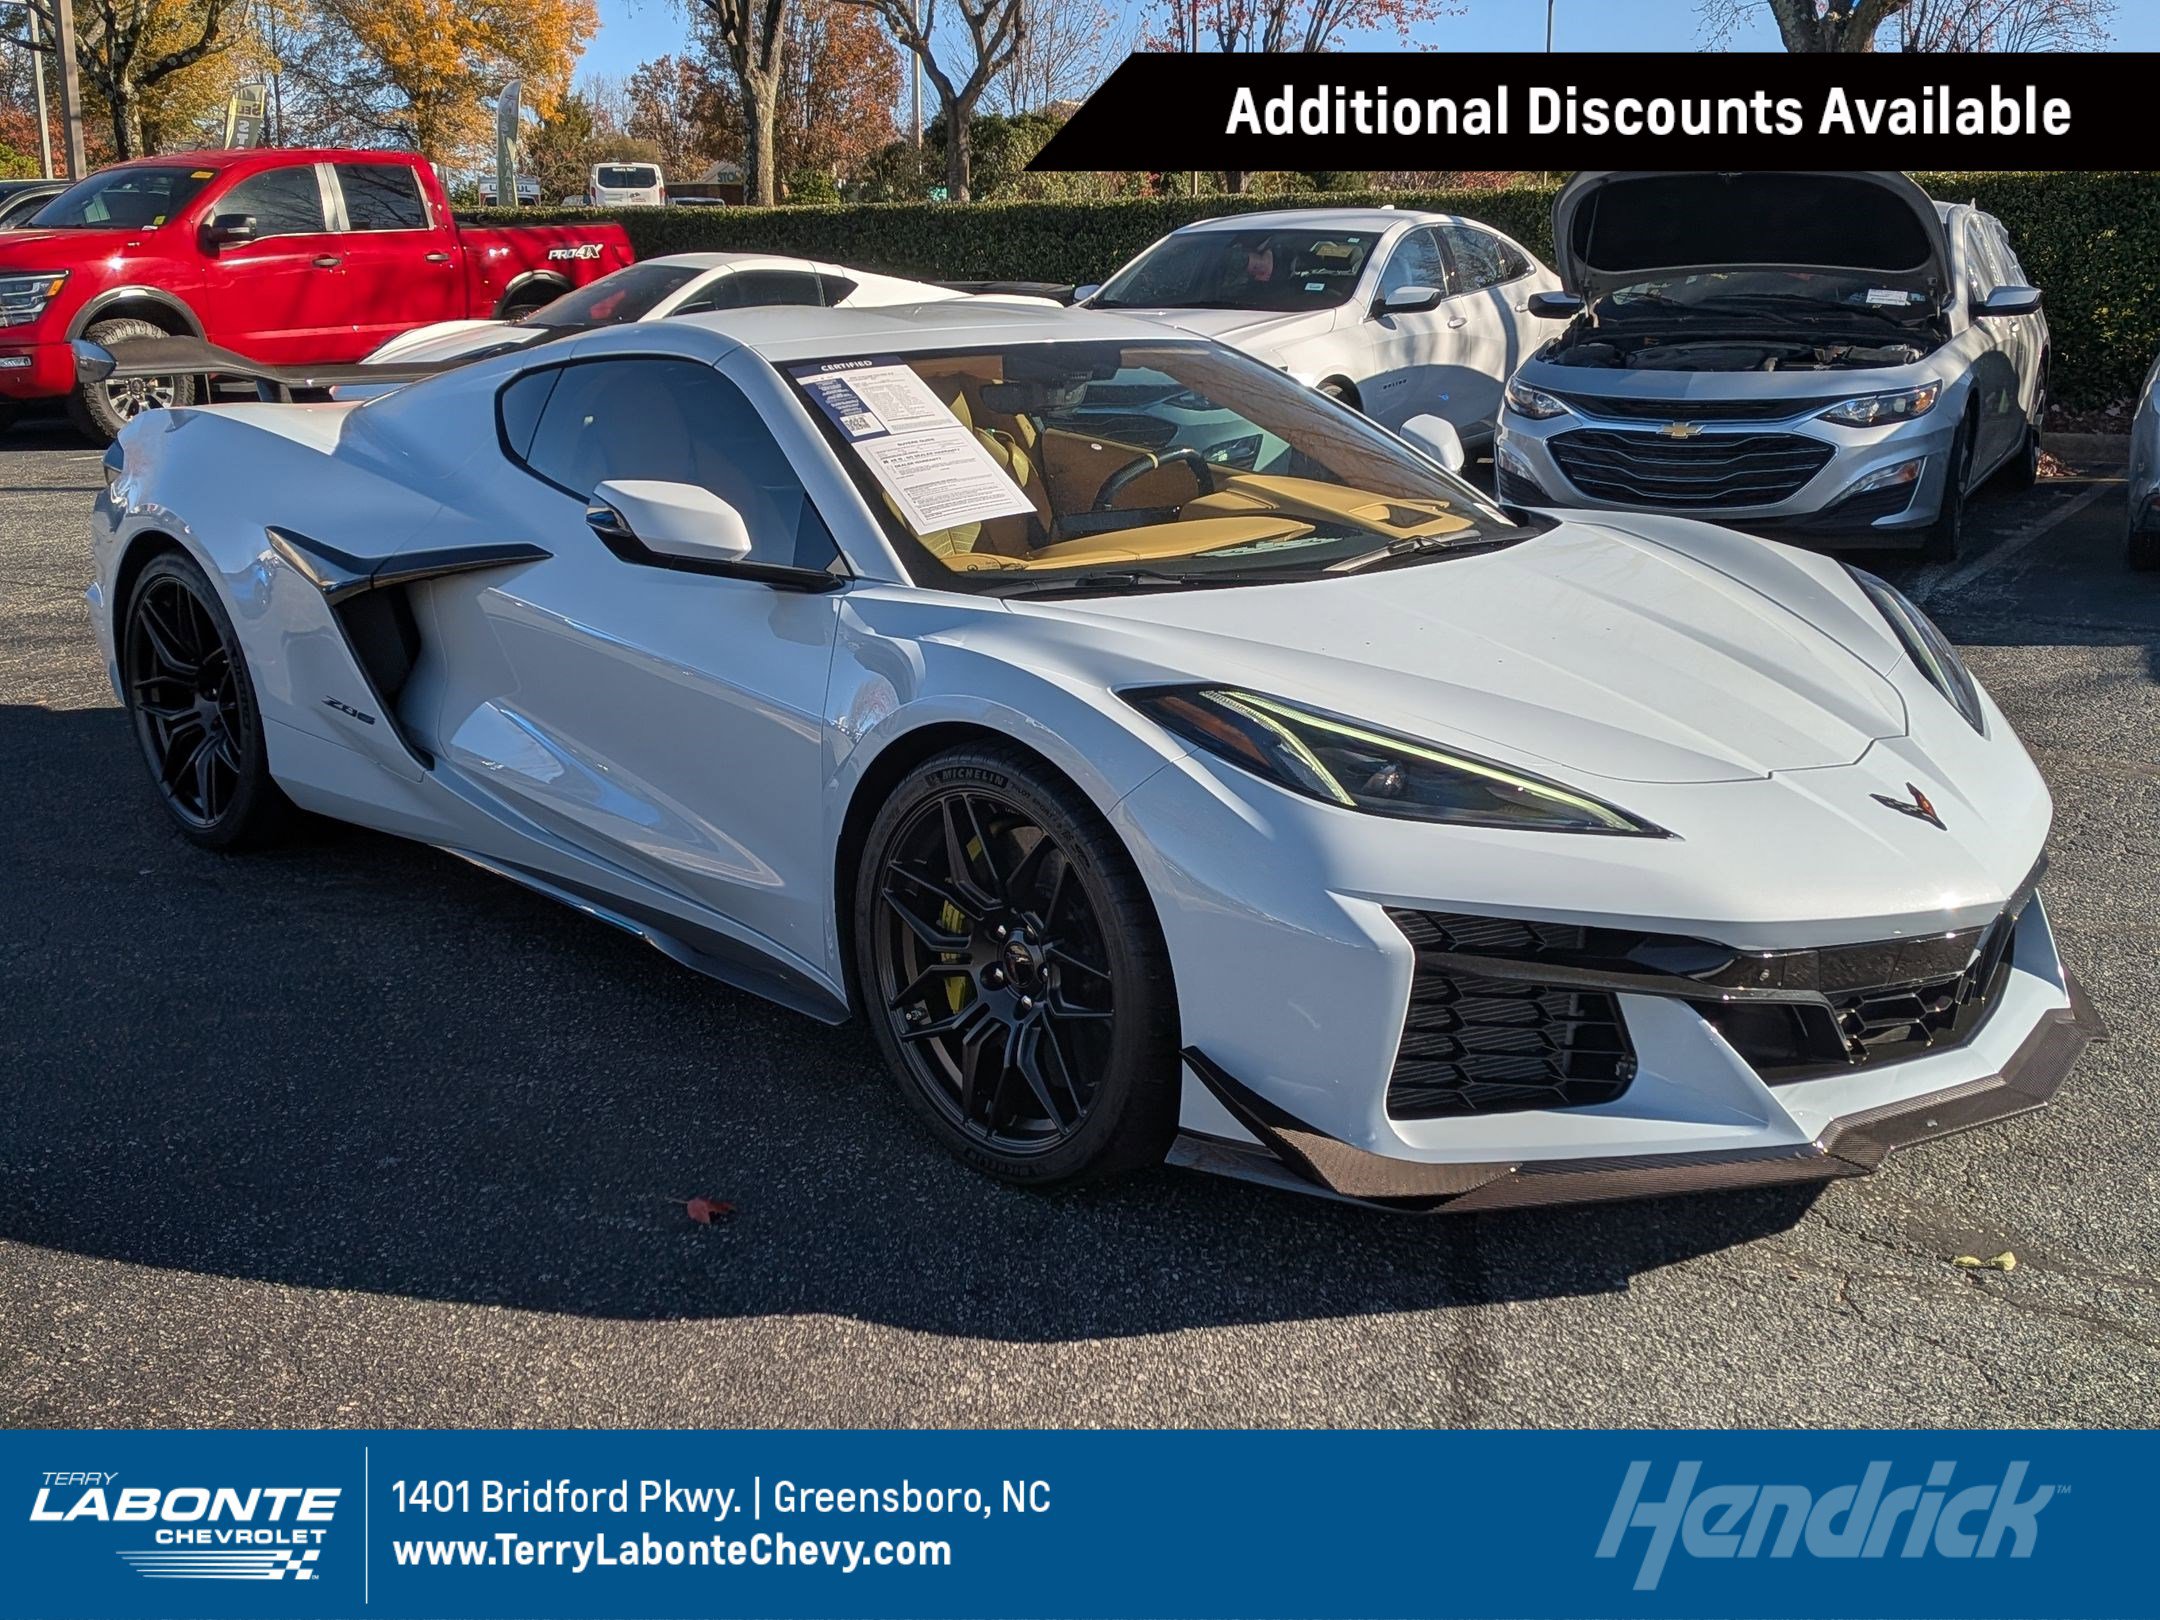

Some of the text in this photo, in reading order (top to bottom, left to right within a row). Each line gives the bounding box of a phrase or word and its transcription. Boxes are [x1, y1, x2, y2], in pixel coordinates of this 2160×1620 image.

[821, 360, 873, 372] CERTIFIED
[321, 695, 376, 725] Z06
[942, 768, 1004, 787] MICHELIN
